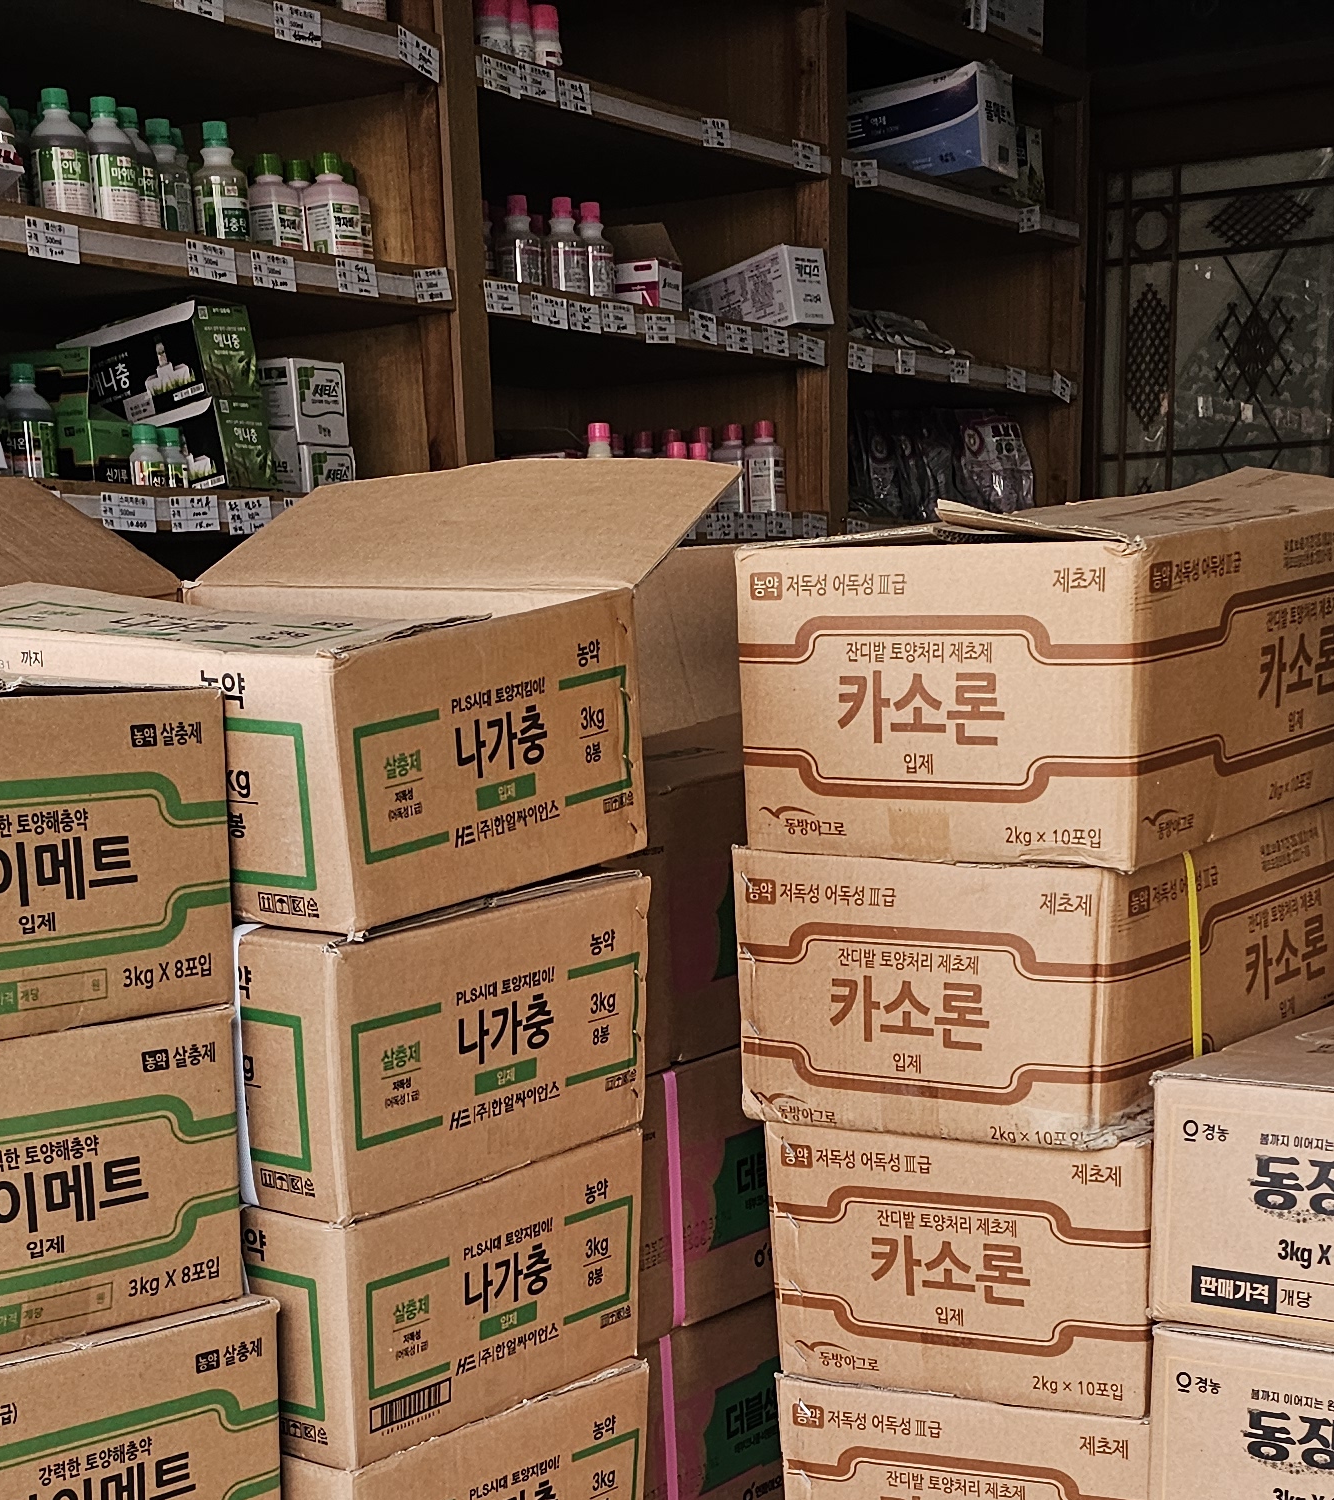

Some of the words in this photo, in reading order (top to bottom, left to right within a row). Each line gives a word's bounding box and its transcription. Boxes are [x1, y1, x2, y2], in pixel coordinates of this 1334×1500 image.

[752, 574, 779, 598] 농약
[787, 574, 827, 597] 저독성
[832, 573, 873, 596] 어독성
[1053, 567, 1106, 592] 제초제
[21, 649, 44, 668] 까지
[577, 639, 601, 668] 농약
[845, 641, 885, 663] 잔디밭
[888, 641, 945, 663] 토양처리
[949, 642, 993, 664] 제초제
[451, 691, 492, 715] PLS시대
[837, 670, 1005, 747] 카소론
[580, 705, 606, 730] 3kg
[160, 723, 202, 746] 살충제
[454, 705, 548, 780] 나가충
[384, 749, 422, 779] 살충제
[903, 753, 934, 776] 입제
[17, 809, 89, 835] 토양해충약
[785, 817, 847, 837] 동방아그로
[1005, 827, 1032, 847] 2kg
[1053, 827, 1102, 848] 10포입
[829, 975, 991, 1052] 카소론
[458, 992, 555, 1065] 나가충
[1202, 1122, 1229, 1142] 경농
[1293, 1136, 1334, 1153] 이어지는
[1071, 1163, 1123, 1188] 제초제
[1277, 1238, 1313, 1266] 3kg
[464, 1243, 553, 1313] 나가충
[871, 1234, 1033, 1307] 카소론
[1199, 1275, 1270, 1305] 판매가격
[1279, 1287, 1312, 1310] 개당
